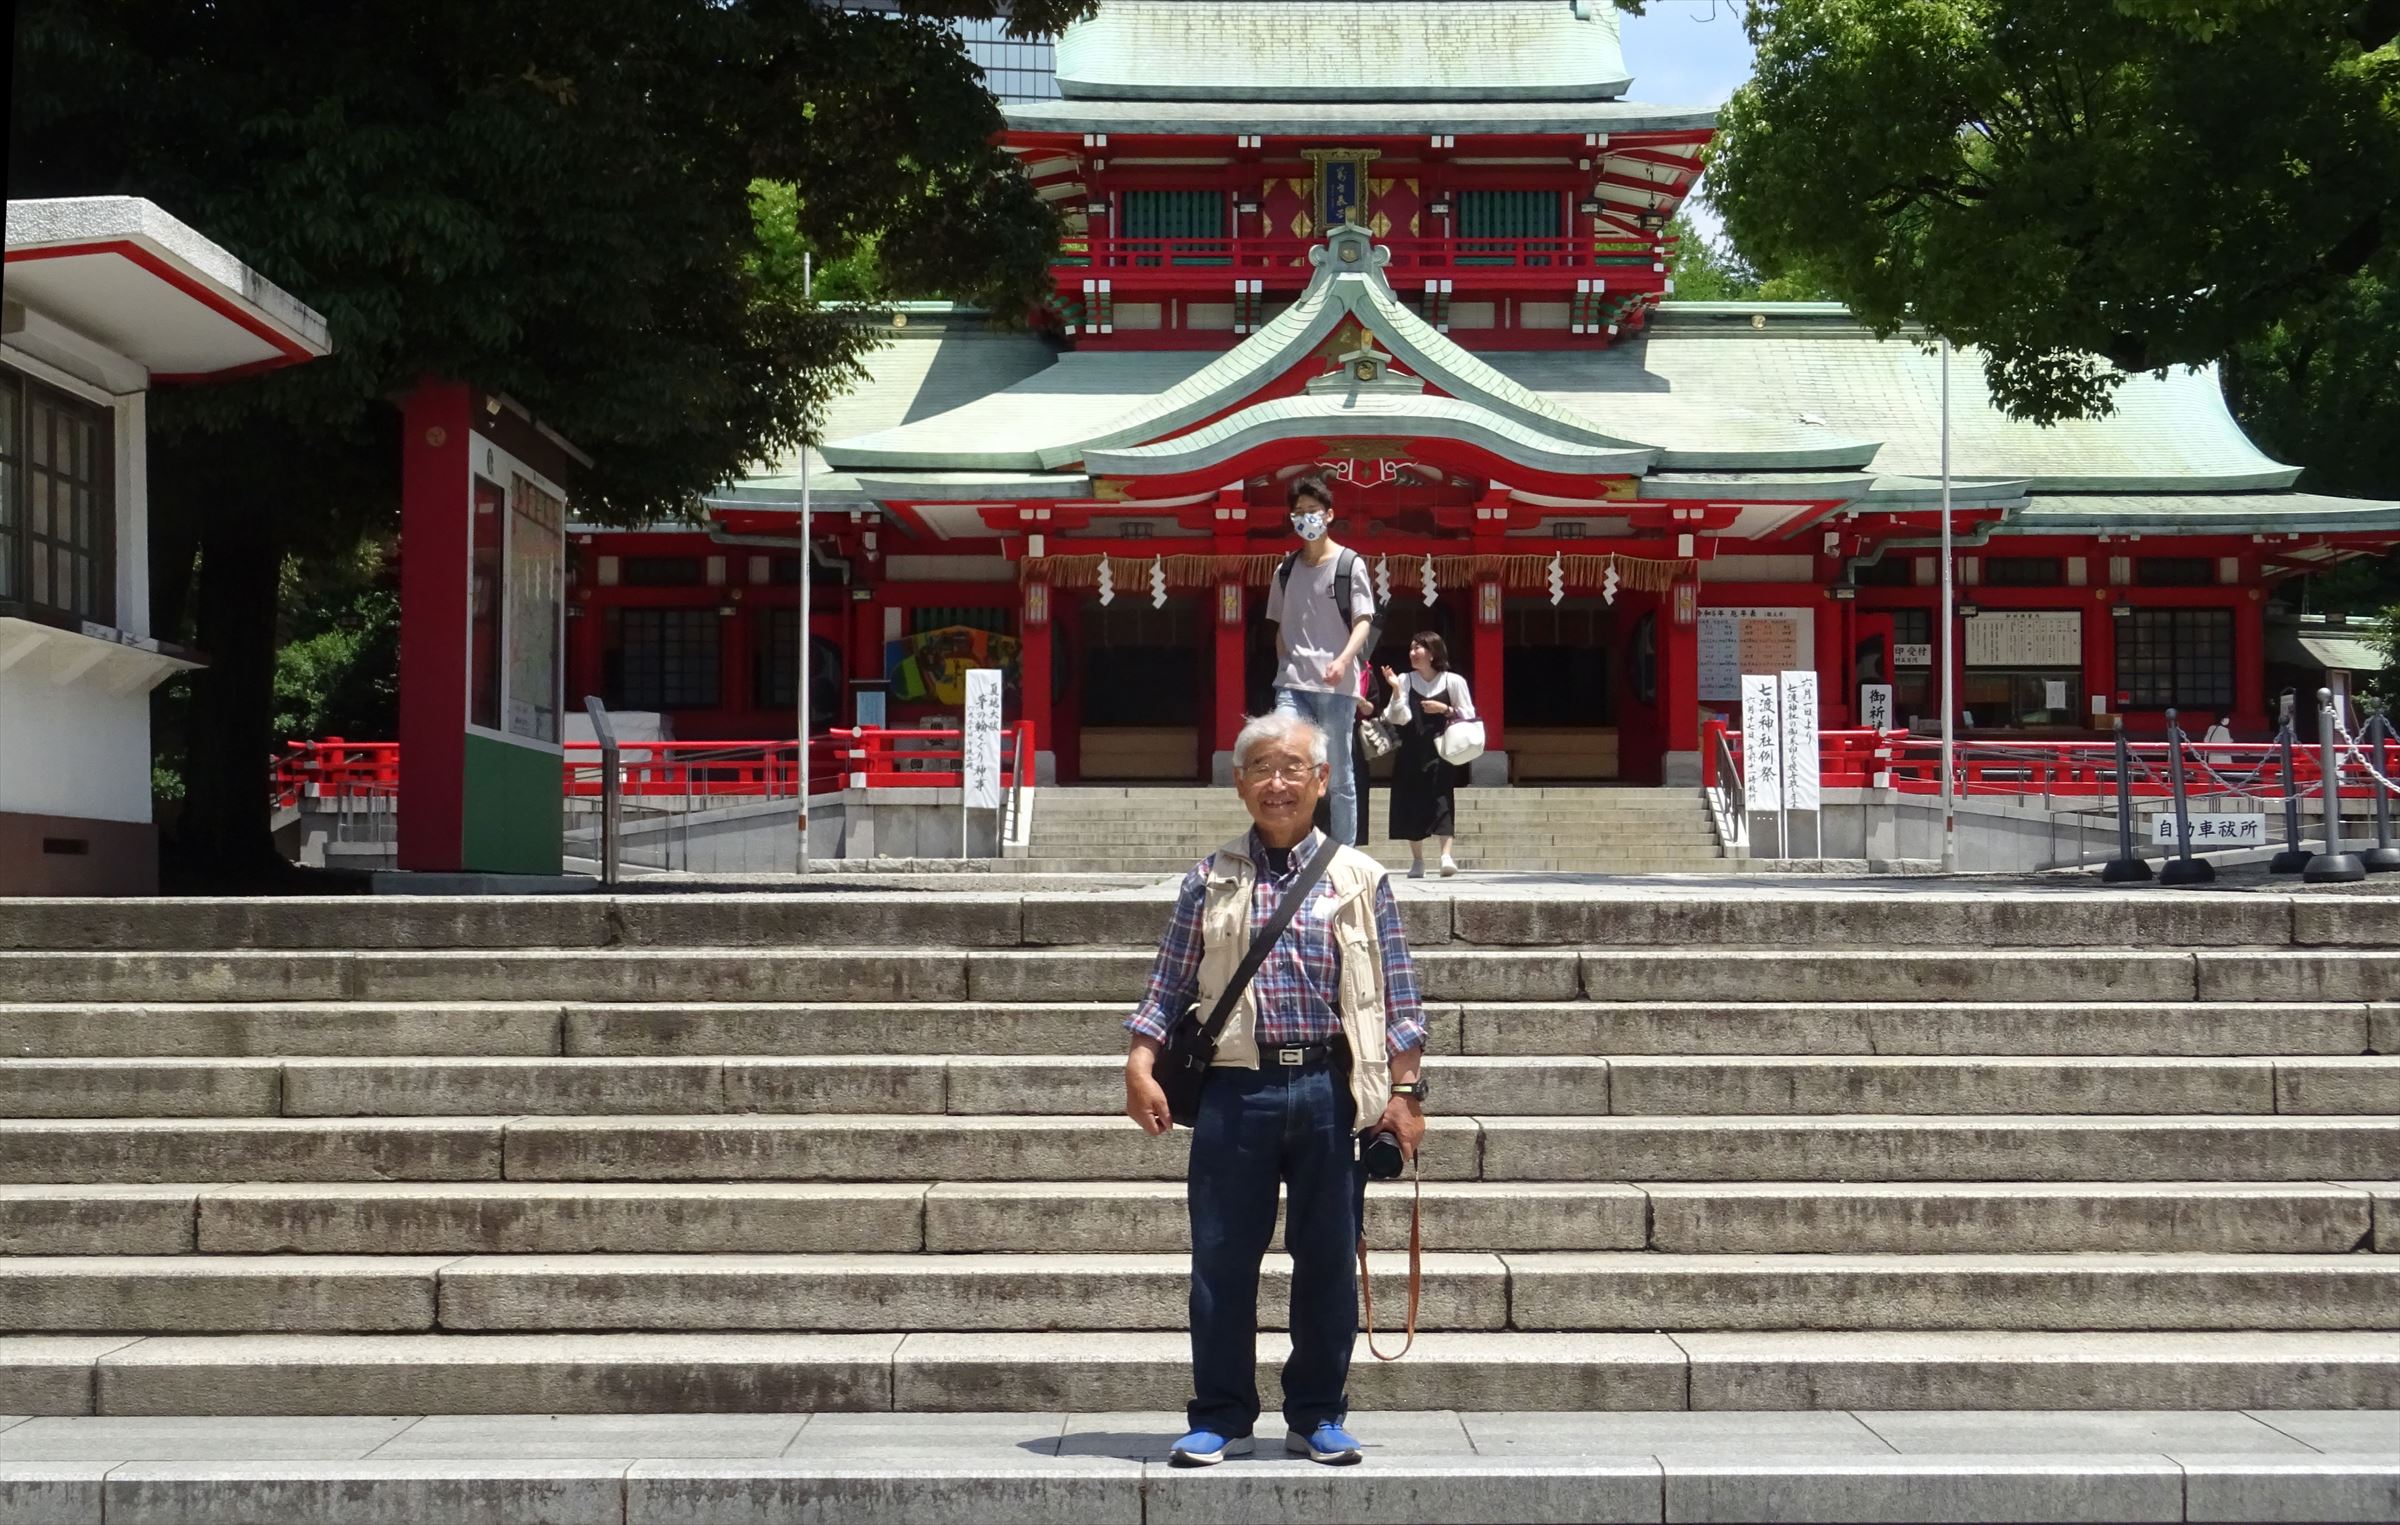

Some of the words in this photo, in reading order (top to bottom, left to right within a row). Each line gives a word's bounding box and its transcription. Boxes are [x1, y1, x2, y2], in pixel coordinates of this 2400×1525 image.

[975, 693, 988, 792] 茅の輪くぐり神事
[1758, 683, 1776, 782] 七渡神社例祭
